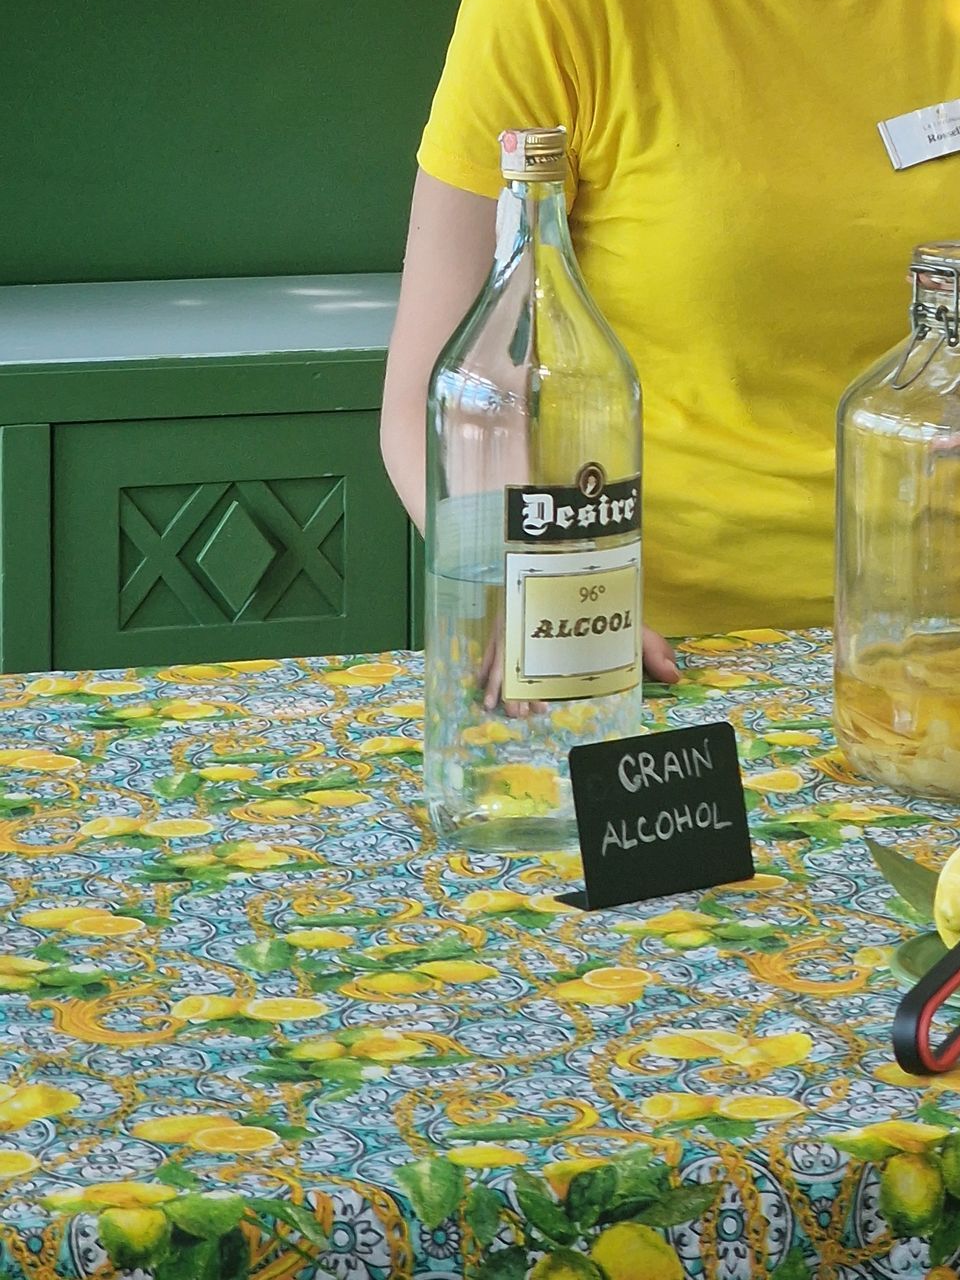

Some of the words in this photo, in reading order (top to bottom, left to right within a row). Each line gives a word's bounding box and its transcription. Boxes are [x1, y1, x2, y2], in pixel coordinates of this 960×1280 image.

[530, 610, 632, 640] ALCOOL
[618, 738, 713, 793] GRAIN
[601, 802, 733, 856] ALCOHOL
